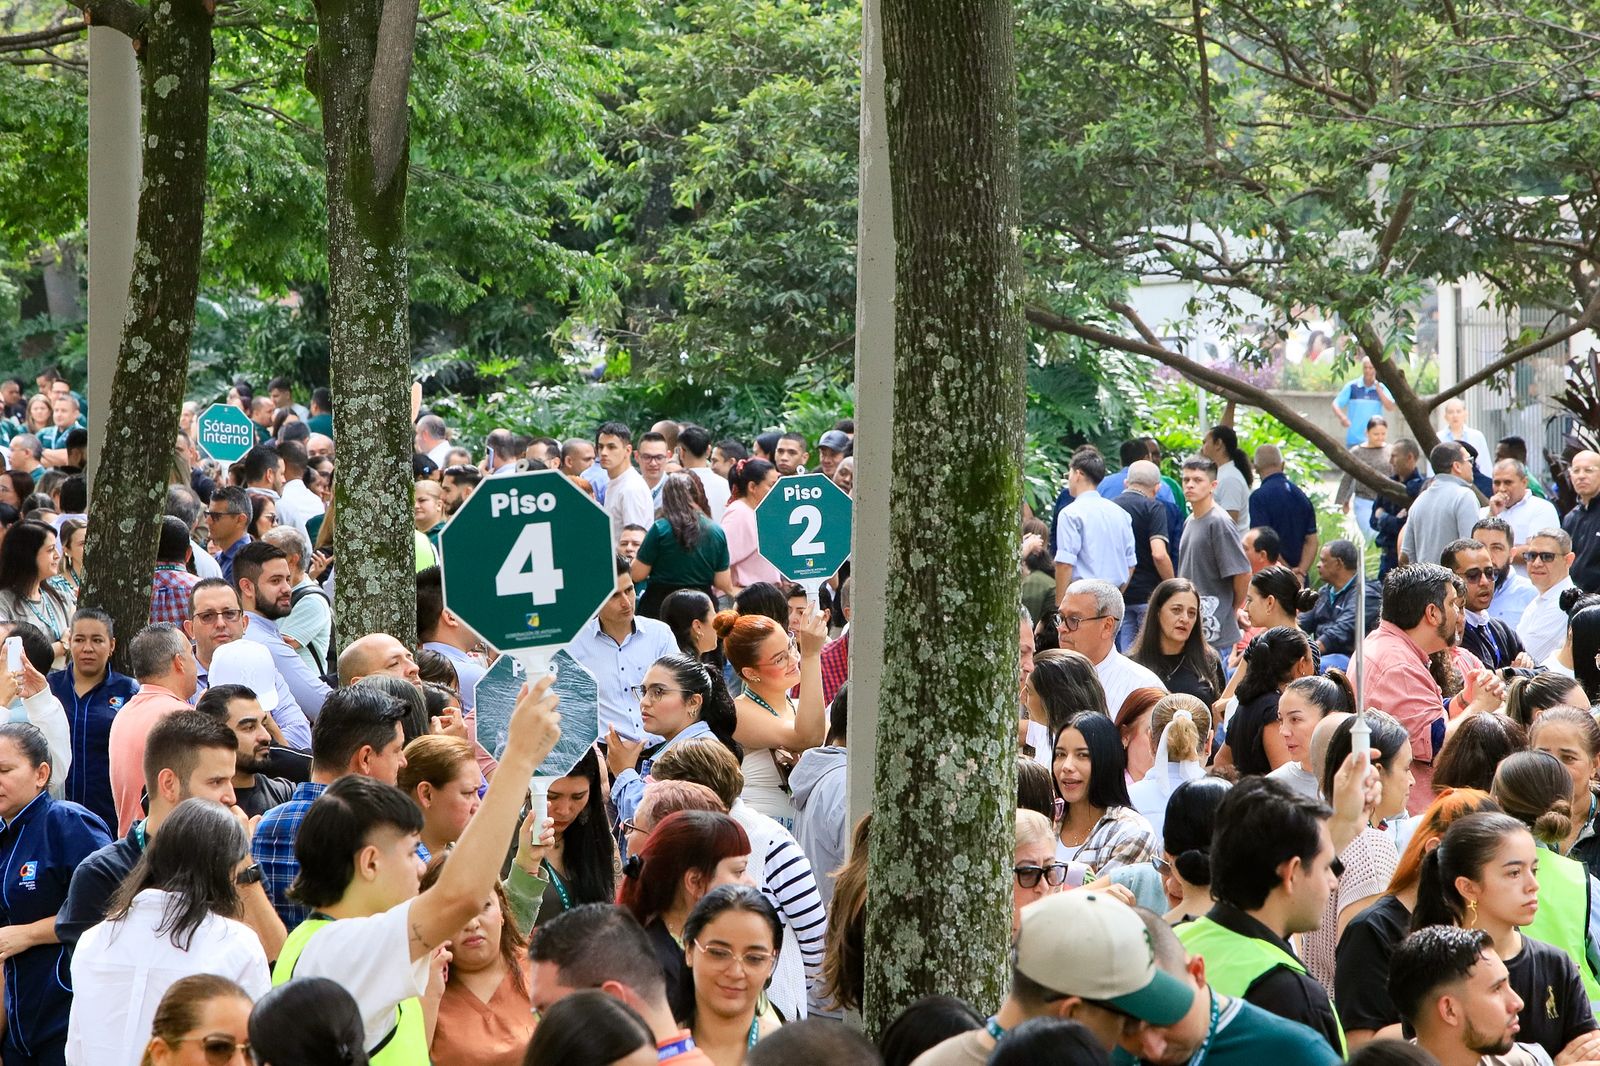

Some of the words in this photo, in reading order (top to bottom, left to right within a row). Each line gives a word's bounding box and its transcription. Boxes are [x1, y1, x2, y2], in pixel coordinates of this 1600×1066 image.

[203, 419, 249, 435] Sótano
[203, 428, 250, 446] interno
[784, 484, 823, 502] Piso
[490, 488, 557, 518] Piso
[788, 504, 826, 556] 2
[495, 521, 564, 606] 4
[512, 659, 559, 677] Po
